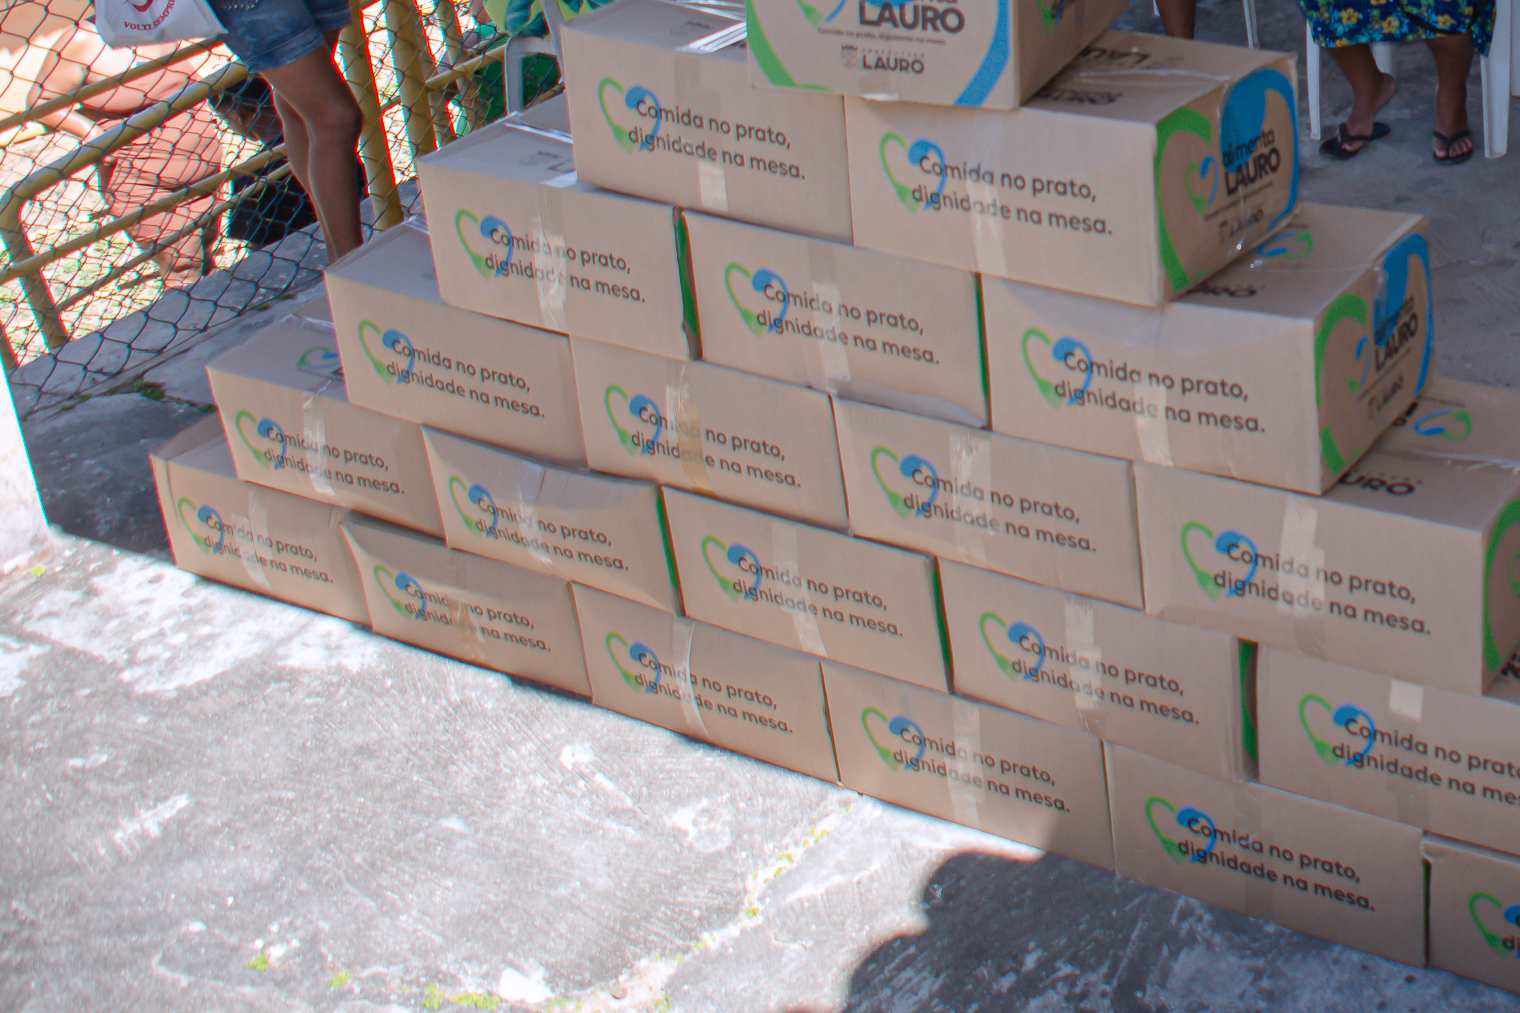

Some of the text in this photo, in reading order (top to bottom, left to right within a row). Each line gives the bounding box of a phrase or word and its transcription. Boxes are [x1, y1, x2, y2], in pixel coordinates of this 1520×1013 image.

[859, 0, 965, 34] LAURO
[863, 54, 924, 74] LAURO
[636, 96, 790, 151] Comida no prato,
[628, 125, 805, 180] dignidade na mesa.
[918, 152, 1096, 205] Comida no prato,
[1225, 146, 1281, 196] LAURO
[912, 183, 1112, 236] dignidade na mesa.
[555, 245, 575, 261] no
[579, 250, 630, 276] prato,
[568, 275, 590, 293] na
[593, 280, 645, 303] mesa.
[763, 281, 923, 337] Comida no prato,
[756, 308, 939, 366] dignidade na mesa.
[386, 361, 544, 420] dignidade na mesa.
[391, 338, 529, 394] Comida no prato,
[1063, 350, 1248, 405] Comida no prato,
[1055, 380, 1266, 436] dignidade na mesa.
[321, 444, 338, 458] no
[342, 449, 388, 473] prato,
[705, 429, 726, 445] no
[731, 435, 784, 463] prato,
[333, 470, 354, 486] na
[356, 475, 403, 497] mesa.
[717, 458, 741, 476] na
[745, 464, 801, 491] mesa.
[911, 467, 1079, 526] Comida no prato,
[1339, 474, 1415, 496] URO
[205, 515, 316, 563] Comida no prato,
[475, 519, 629, 575] dignidade na mesa.
[535, 518, 555, 533] no
[559, 524, 611, 550] prato,
[903, 493, 1096, 554] dignidade na mesa.
[268, 558, 287, 574] na
[288, 564, 332, 586] mesa.
[737, 555, 887, 613] Comida no prato,
[1226, 541, 1416, 606] Comida no prato,
[462, 602, 482, 616] no
[485, 608, 533, 632] prato,
[732, 578, 903, 639] dignidade na mesa.
[1213, 569, 1431, 637] dignidade na mesa.
[478, 626, 500, 640] na
[501, 631, 551, 653] mesa.
[1018, 634, 1184, 699] Comida no prato,
[634, 673, 793, 737] dignidade na mesa.
[638, 652, 776, 712] Comida no prato,
[1011, 658, 1200, 727] dignidade na mesa.
[899, 726, 1055, 788] Comida no prato,
[1344, 716, 1427, 756] Comida
[1434, 746, 1461, 764] no
[893, 748, 1070, 814] dignidade na mesa.
[1332, 742, 1442, 786] dignidade
[1446, 777, 1476, 797] na
[1178, 839, 1375, 911] dignidade na mesa.
[1187, 816, 1361, 885] Comida no prato,
